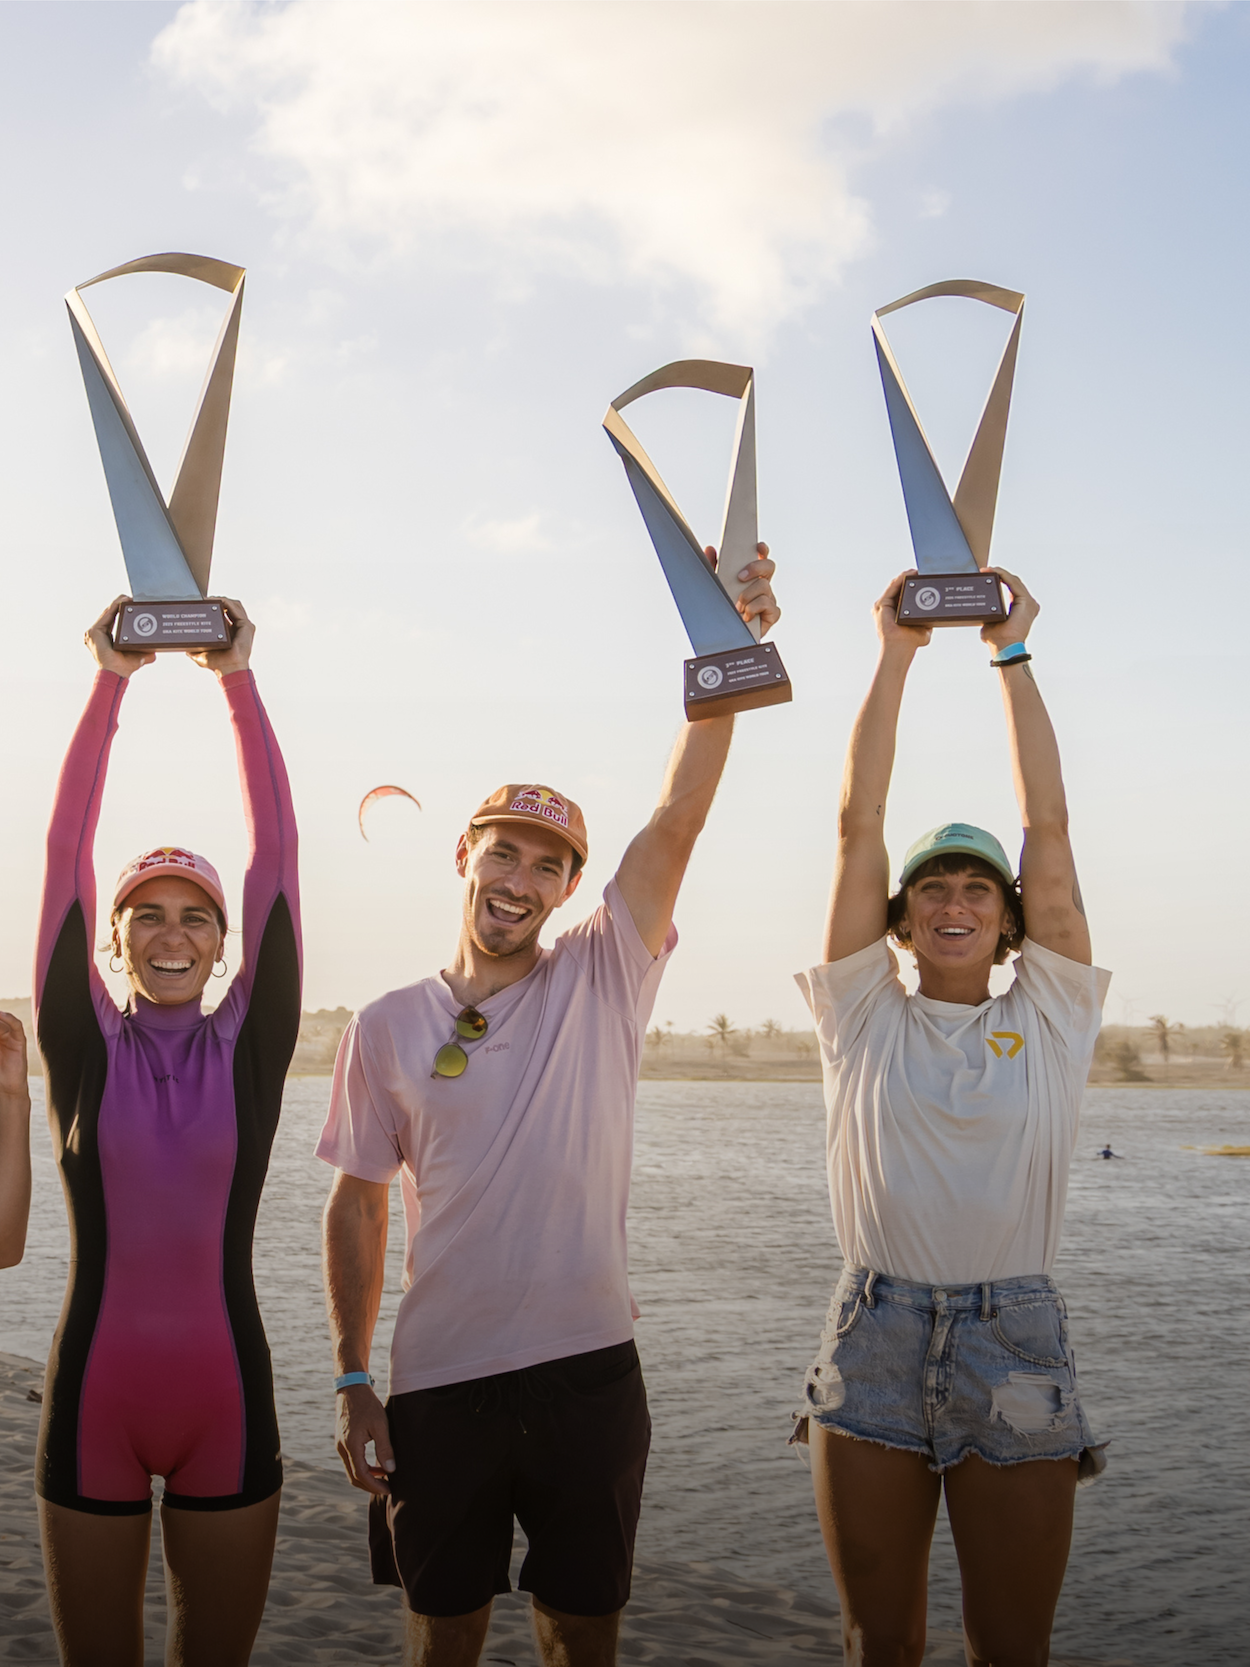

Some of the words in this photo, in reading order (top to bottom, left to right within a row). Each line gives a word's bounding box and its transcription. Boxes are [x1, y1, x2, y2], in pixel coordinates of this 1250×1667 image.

[736, 658, 754, 666] PLACE
[510, 801, 540, 813] Red
[543, 806, 568, 826] Bull
